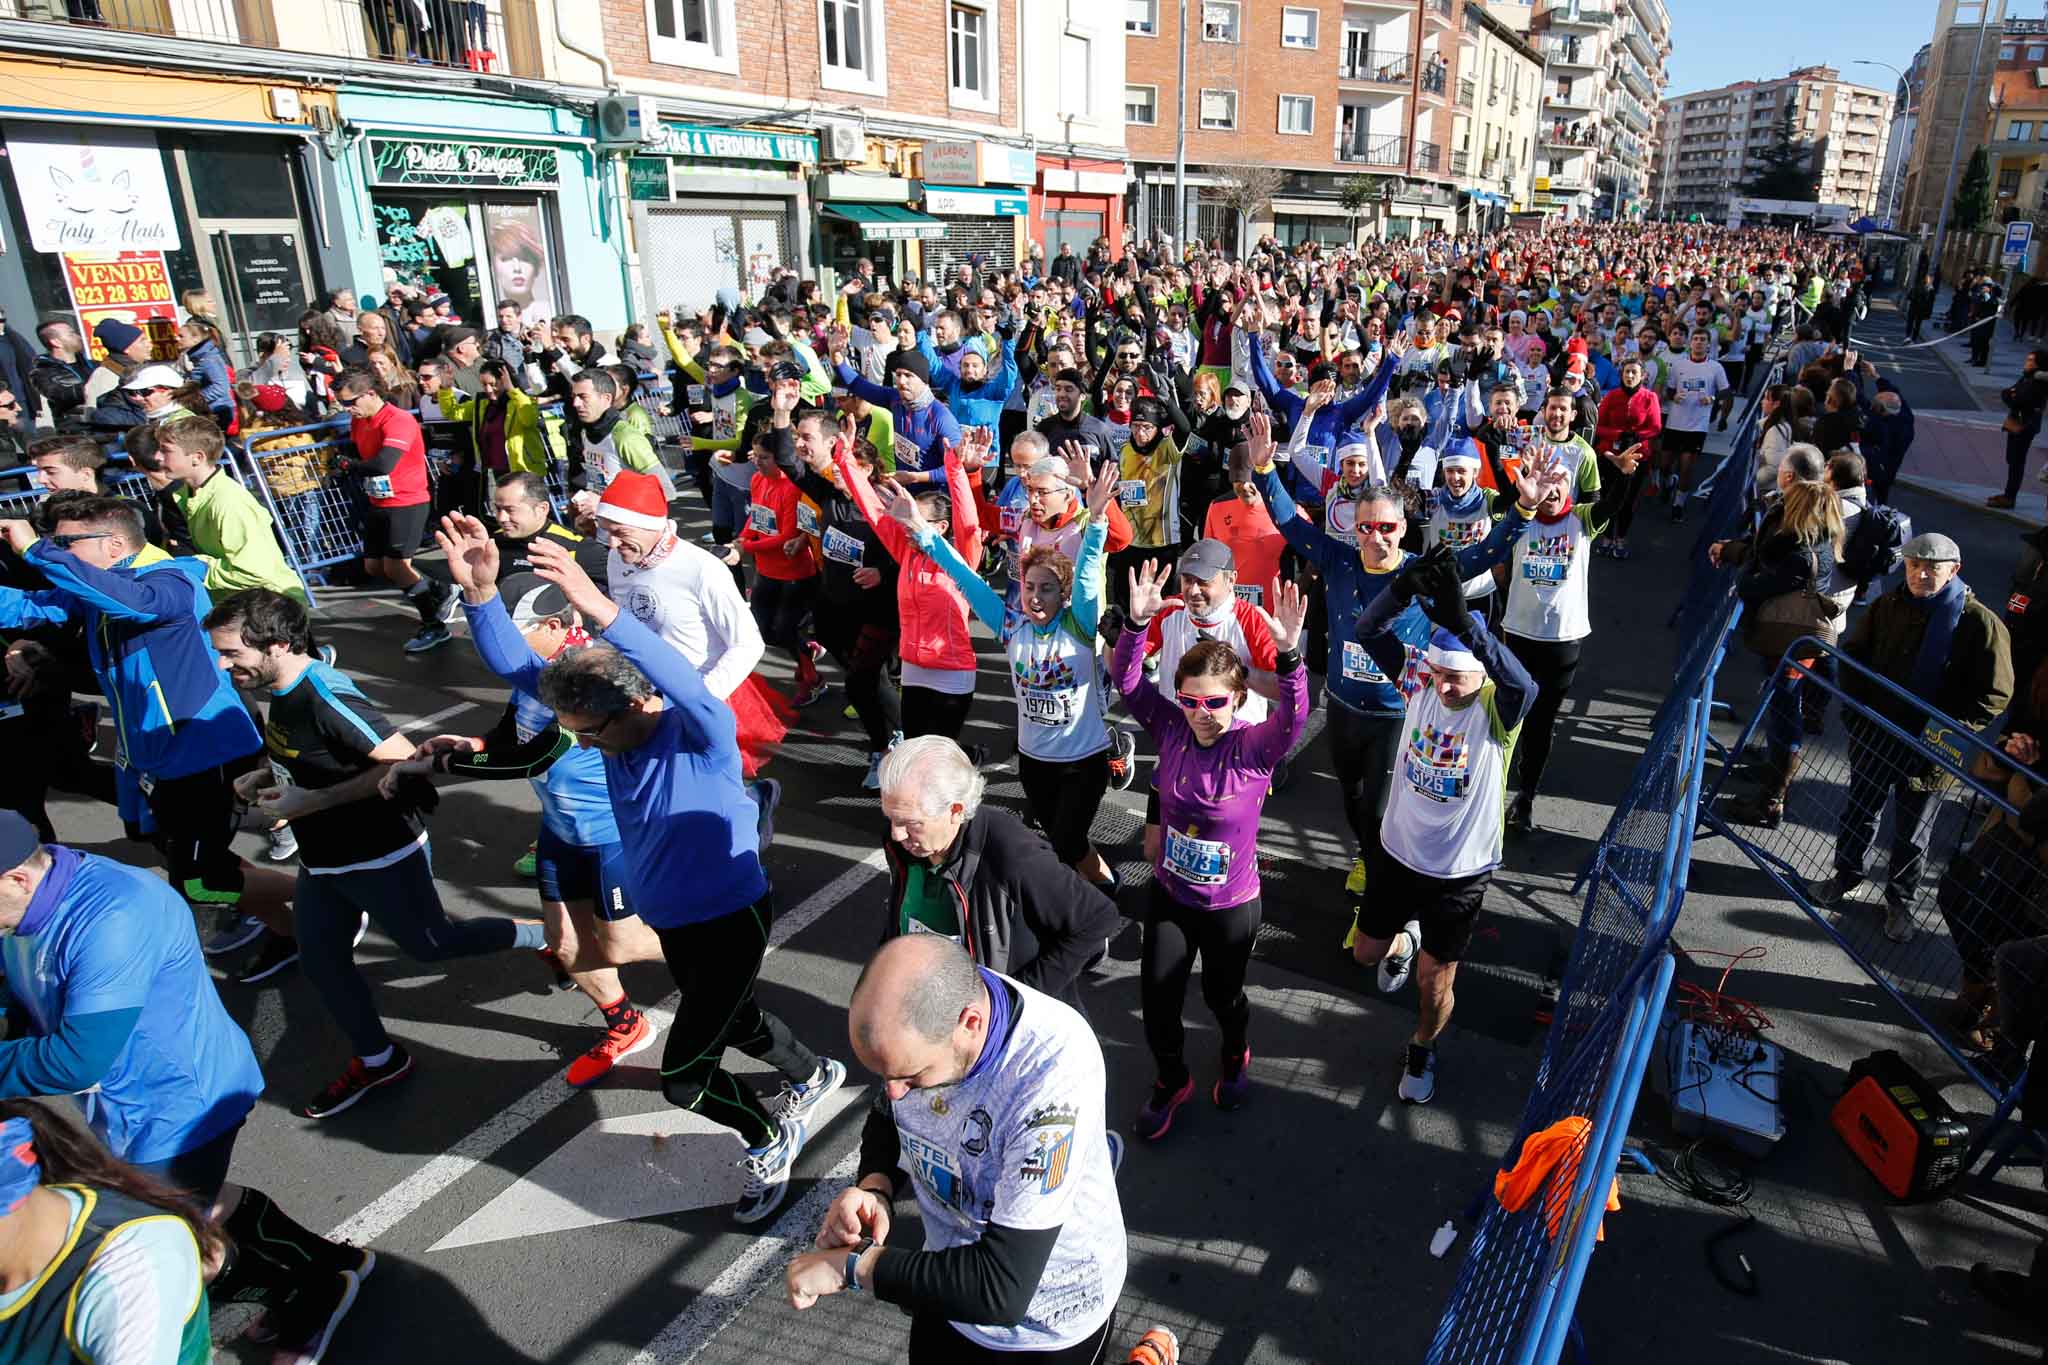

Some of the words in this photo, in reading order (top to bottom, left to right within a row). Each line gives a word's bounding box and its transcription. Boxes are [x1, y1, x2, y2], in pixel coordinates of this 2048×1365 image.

[692, 132, 705, 153] &
[706, 132, 773, 158] VERDURAS
[775, 136, 817, 163] VERA
[406, 145, 462, 171] Prieto
[465, 147, 527, 180] Borges
[70, 262, 163, 285] VENDE
[75, 286, 105, 305] 923
[107, 285, 128, 303] 28
[129, 284, 148, 302] 36
[150, 282, 169, 301] 00
[1530, 563, 1555, 578] 5137
[1350, 653, 1380, 672] 567
[1026, 697, 1055, 714] 1970
[1411, 766, 1444, 794] 5126
[1171, 840, 1212, 871] 6473
